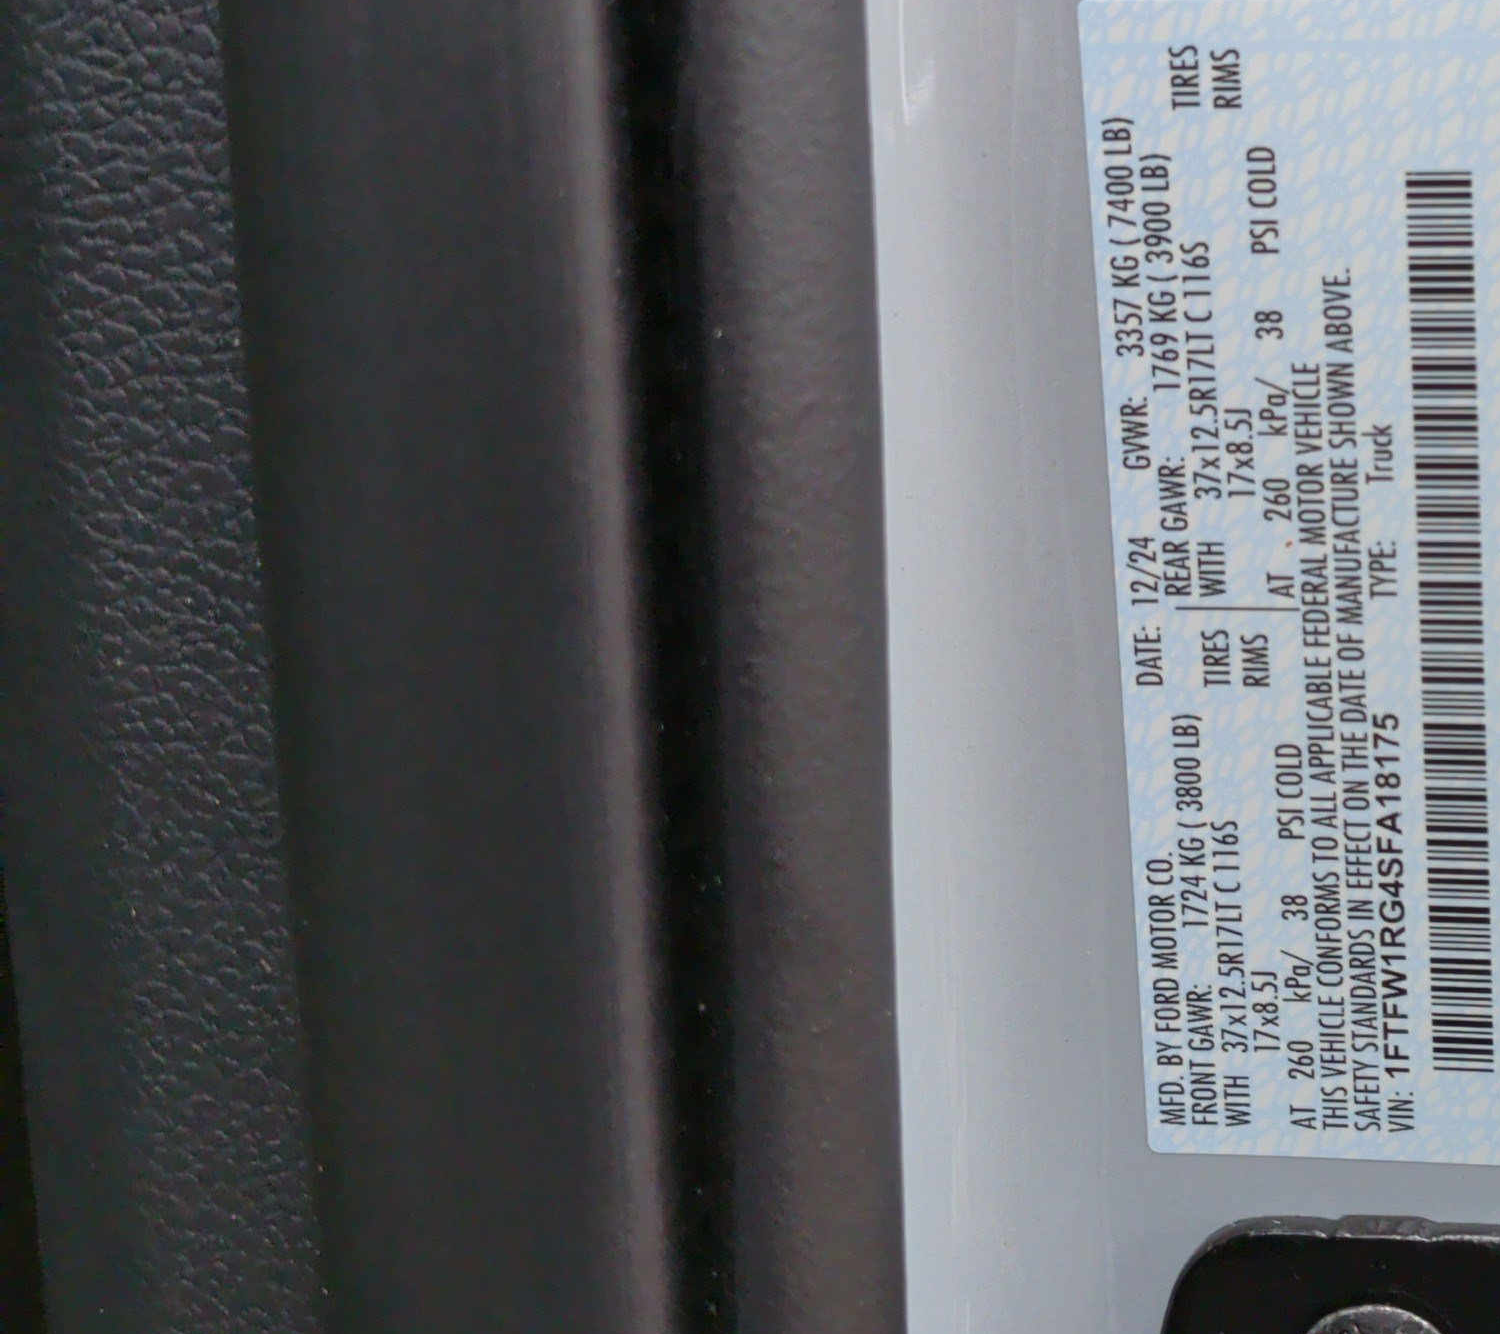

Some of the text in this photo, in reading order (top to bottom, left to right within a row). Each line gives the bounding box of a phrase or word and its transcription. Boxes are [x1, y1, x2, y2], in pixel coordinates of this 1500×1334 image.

[1169, 45, 1201, 109] TIRES
[1210, 49, 1242, 110] RIMS
[1102, 116, 1151, 470] GVWR: 3357 KG 7400 LB)
[1140, 154, 1192, 596] REAR GAWR: 1769 KG 3900 LB)
[1180, 241, 1225, 597] WITH 37x12.5R17LT 116S
[1246, 146, 1294, 598] AT 260 kPa/ 38 PSI COLD
[1226, 407, 1255, 499] 17x8.5J
[1363, 424, 1397, 599] TYPE: Truck
[1128, 536, 1163, 686] DATE: 12/24
[1203, 630, 1230, 686] TIRES
[1242, 635, 1268, 687] RIMS
[1292, 362, 1348, 1129] THIS VEHICLE CONFORMS TO ALL APPLICABLE FEDERAL MOTOR VEHICLE
[1323, 268, 1381, 1131] SAFETY STANDARDS IN EFFECT ON THE DATE OF MANUFACTURE SHOWN ABOVE.
[1146, 852, 1186, 1126] MFD. BY FORD MOTOR CO.
[1172, 714, 1217, 1126] FRONT GAWR: 1724 KG 3800 LB)
[1212, 820, 1251, 1127] WITH 37x12.5R17LT 116S
[1253, 971, 1280, 1052] 17x8.5J
[1275, 744, 1316, 1128] AT 260 kPa/ 38 PSI COLD
[1372, 712, 1415, 1132] VIN: 1FTFW1RG4SFA18175
